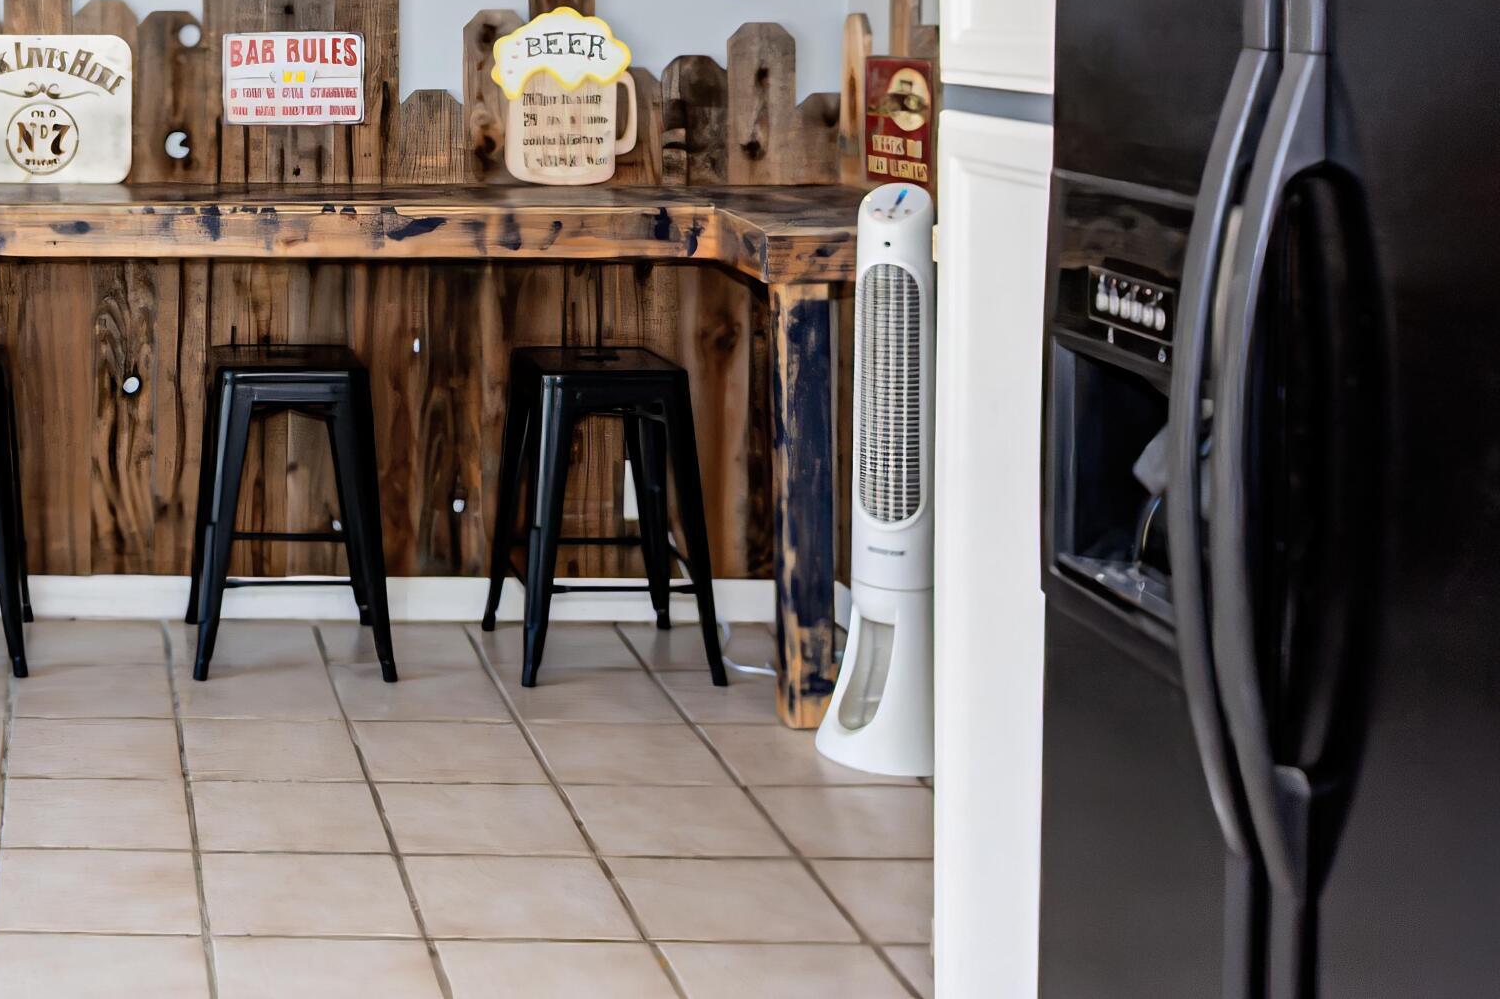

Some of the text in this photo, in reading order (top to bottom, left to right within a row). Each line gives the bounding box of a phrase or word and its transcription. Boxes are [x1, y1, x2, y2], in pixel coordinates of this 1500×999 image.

[230, 38, 358, 68] BAR RULES
[525, 32, 607, 61] BEER
